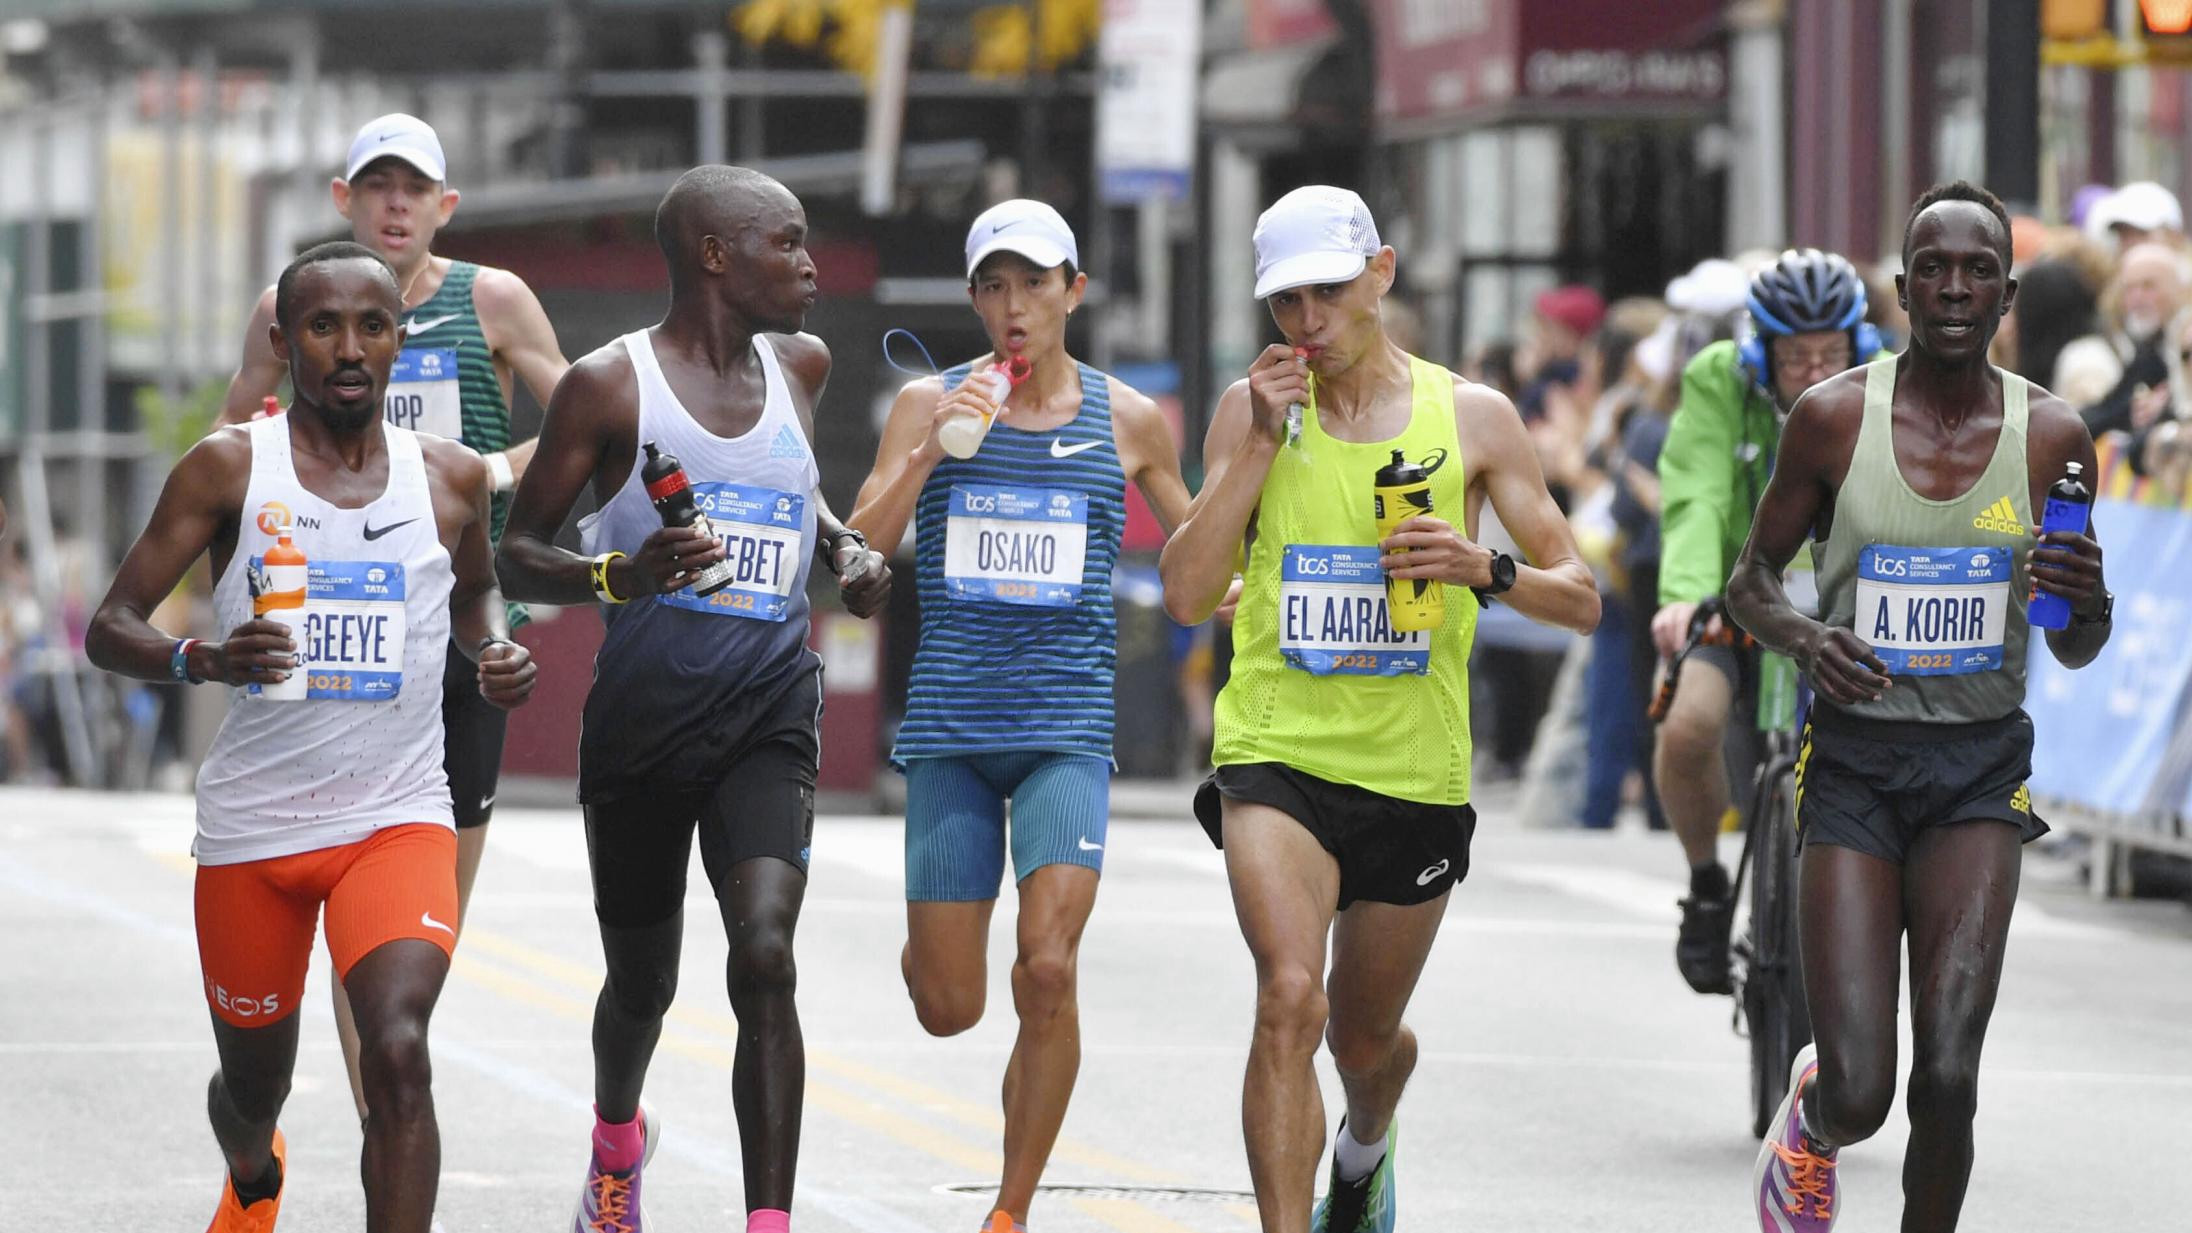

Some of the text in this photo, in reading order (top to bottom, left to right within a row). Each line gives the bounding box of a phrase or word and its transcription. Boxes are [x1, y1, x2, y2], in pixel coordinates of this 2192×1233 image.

[694, 492, 715, 511] cs
[720, 491, 739, 499] TATA
[966, 491, 995, 513] tcs
[773, 512, 792, 523] TATA
[1048, 508, 1072, 518] TATA
[297, 516, 321, 530] NN
[1973, 515, 2024, 536] adidas
[978, 530, 1056, 575] OSAKO
[1297, 553, 1329, 575] tcs
[1331, 561, 1378, 569] CONSULTANCY
[1874, 553, 1906, 576] tcs
[1909, 563, 1956, 571] CONSULTANCY
[1331, 568, 1361, 576] SERVICES
[1909, 570, 1939, 578] SERVICES
[1967, 569, 1992, 578] TATA
[364, 585, 389, 594] TATA
[709, 592, 754, 609] 2022
[1287, 595, 1314, 641] EL
[1874, 595, 1985, 643] A. KORIR
[1332, 655, 1377, 669] 2022
[1907, 654, 1953, 669] 2022
